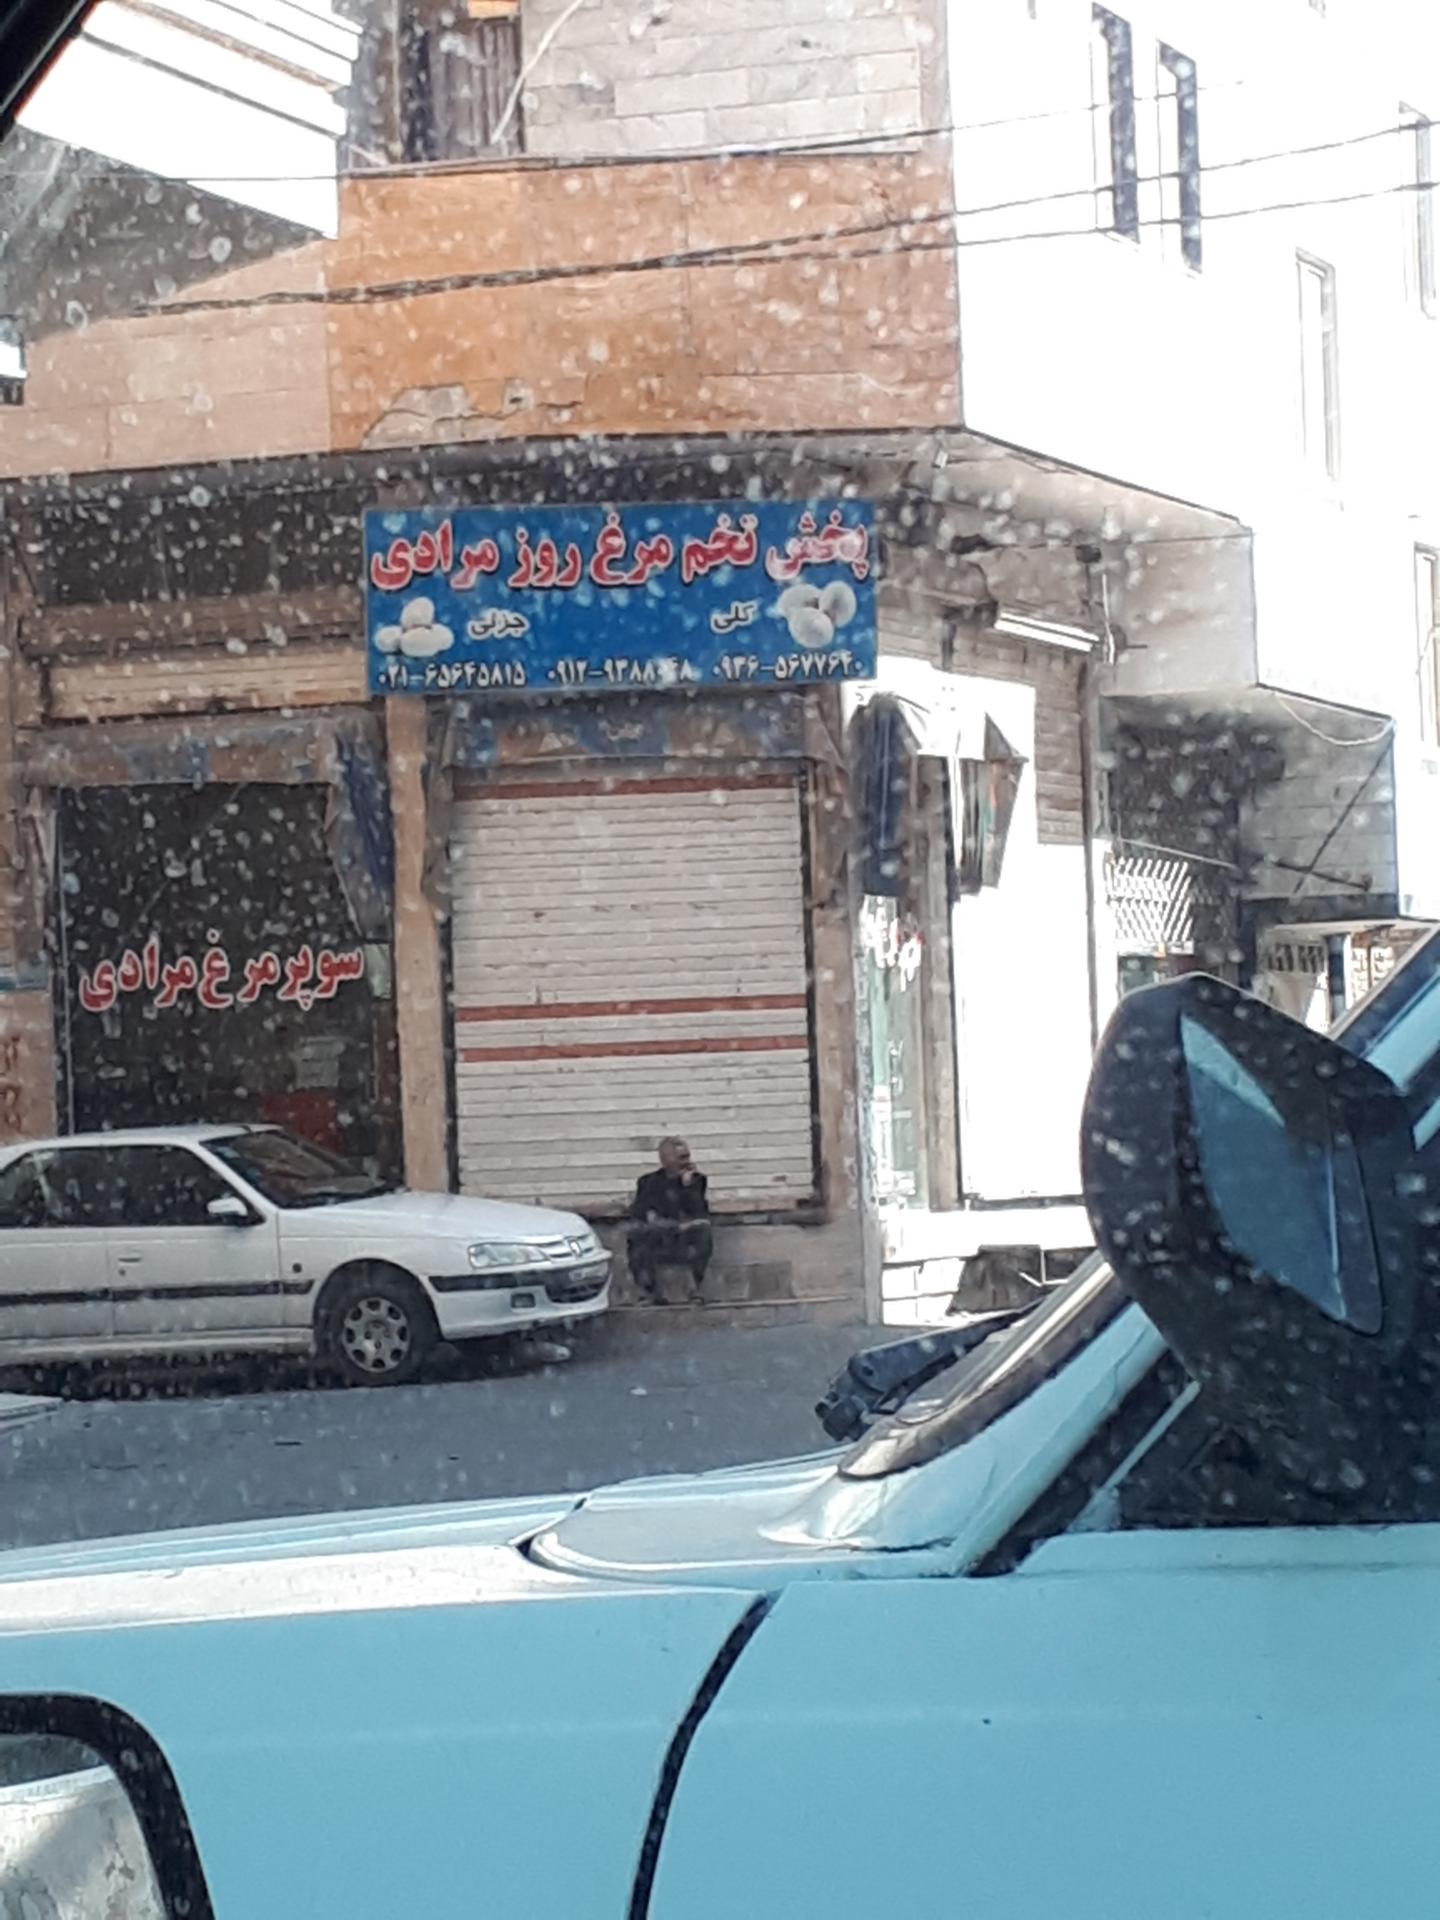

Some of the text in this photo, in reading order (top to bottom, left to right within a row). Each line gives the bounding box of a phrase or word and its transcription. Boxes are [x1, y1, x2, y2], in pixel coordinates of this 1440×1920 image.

[371, 509, 869, 590] پخش تخم مرغ روز مرادی
[710, 600, 758, 635] کلی
[79, 928, 364, 1011] سوپر مرغ مرادی
